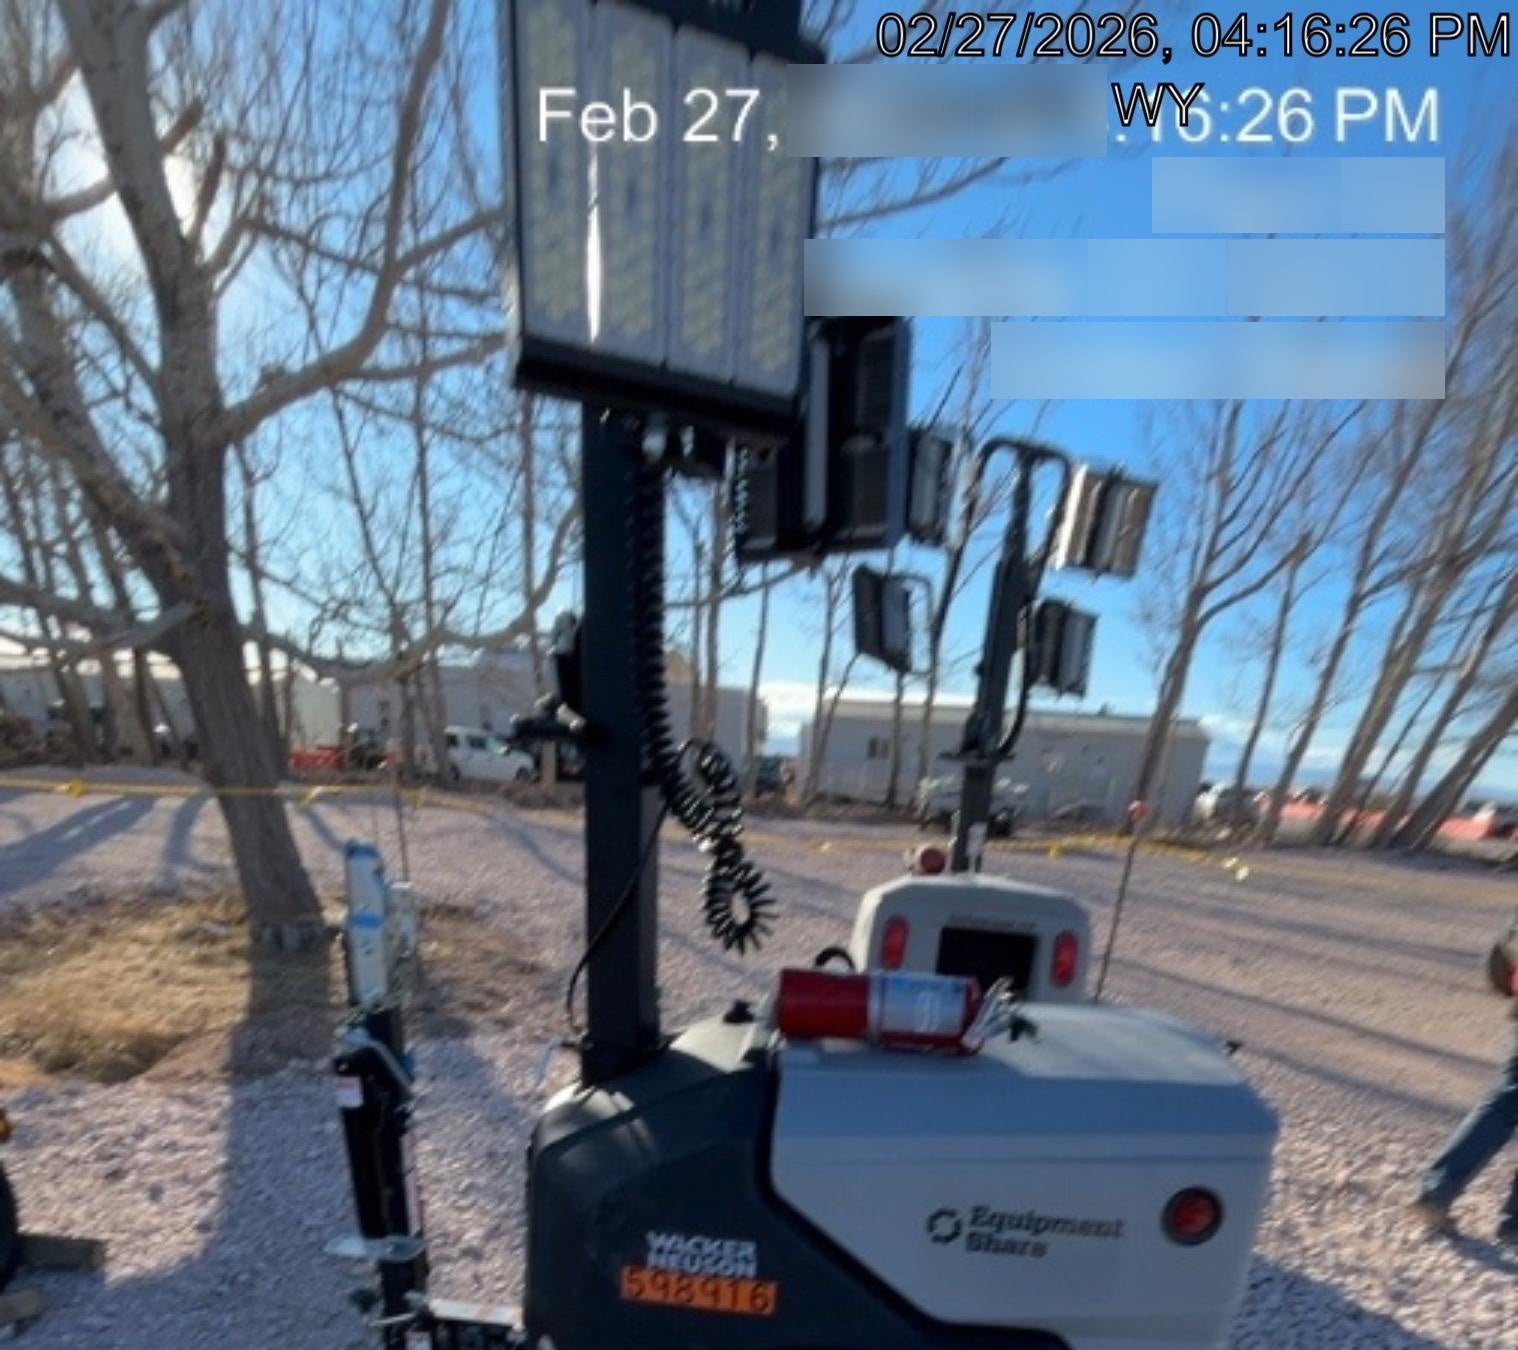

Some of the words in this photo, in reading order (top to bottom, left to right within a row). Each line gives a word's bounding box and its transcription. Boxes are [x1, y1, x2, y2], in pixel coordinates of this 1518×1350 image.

[970, 1205, 1125, 1239] Equipment
[646, 1231, 757, 1255] WACKER
[965, 1231, 1048, 1258] Share
[648, 1252, 756, 1278] NEUSON
[626, 1269, 770, 1312] 598916
